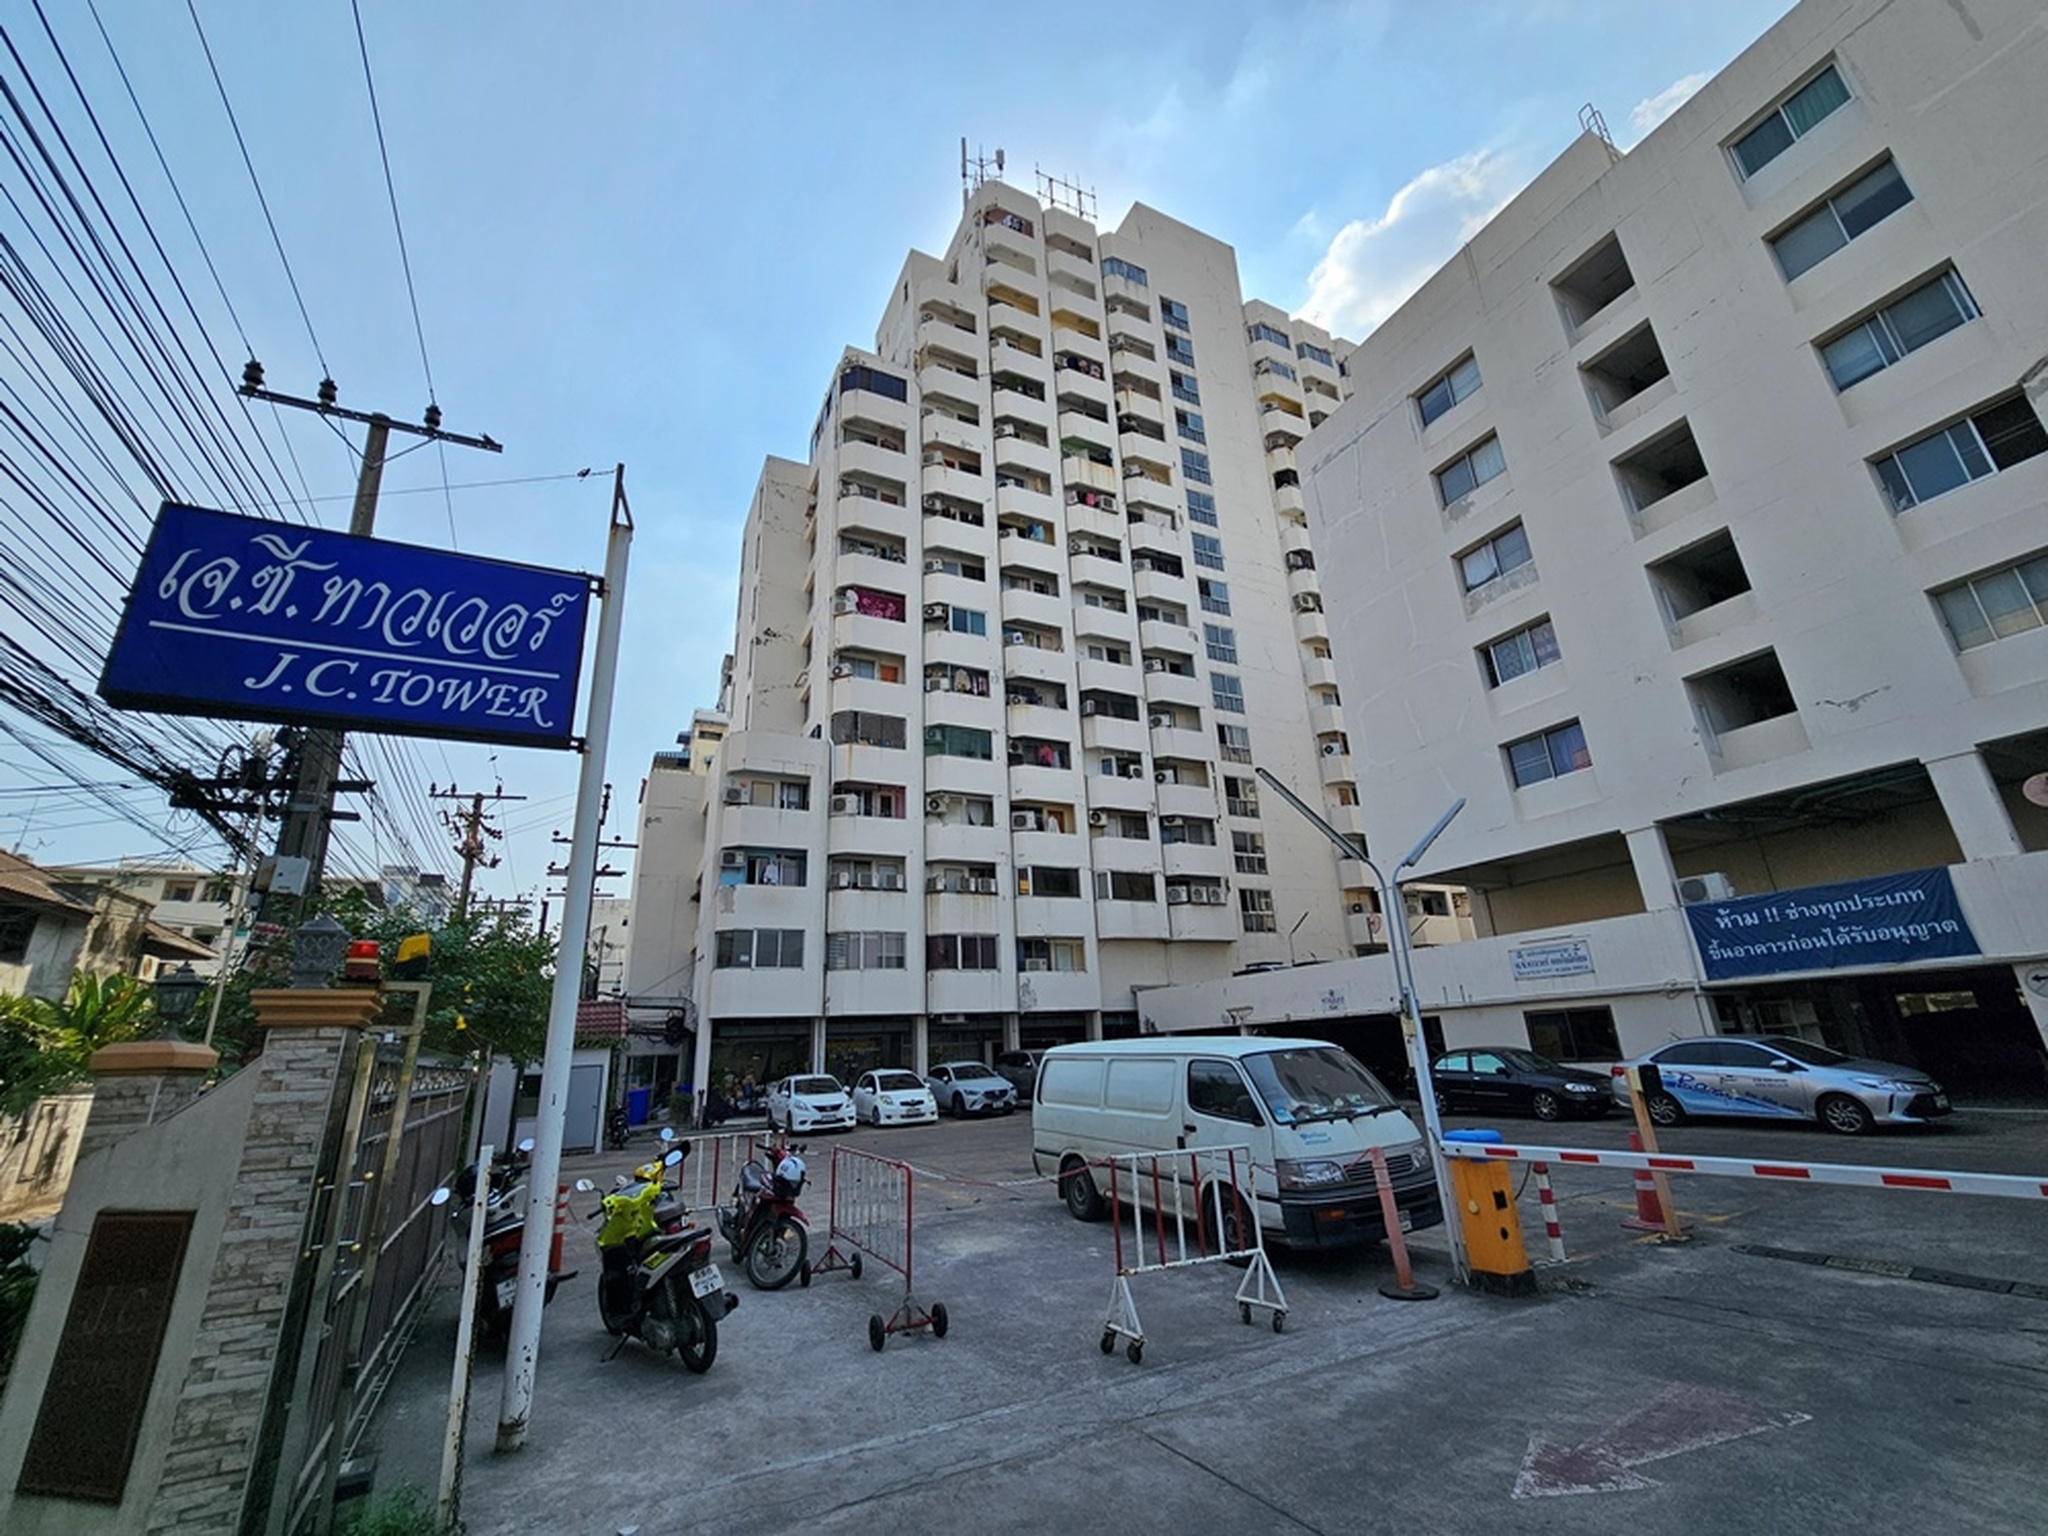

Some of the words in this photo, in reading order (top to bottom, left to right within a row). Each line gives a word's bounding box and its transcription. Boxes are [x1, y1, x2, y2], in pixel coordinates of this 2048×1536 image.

[370, 670, 553, 728] TOWER
[1715, 907, 1759, 929] ห้าม
[1785, 888, 1925, 921] ช่างทุกประเภท
